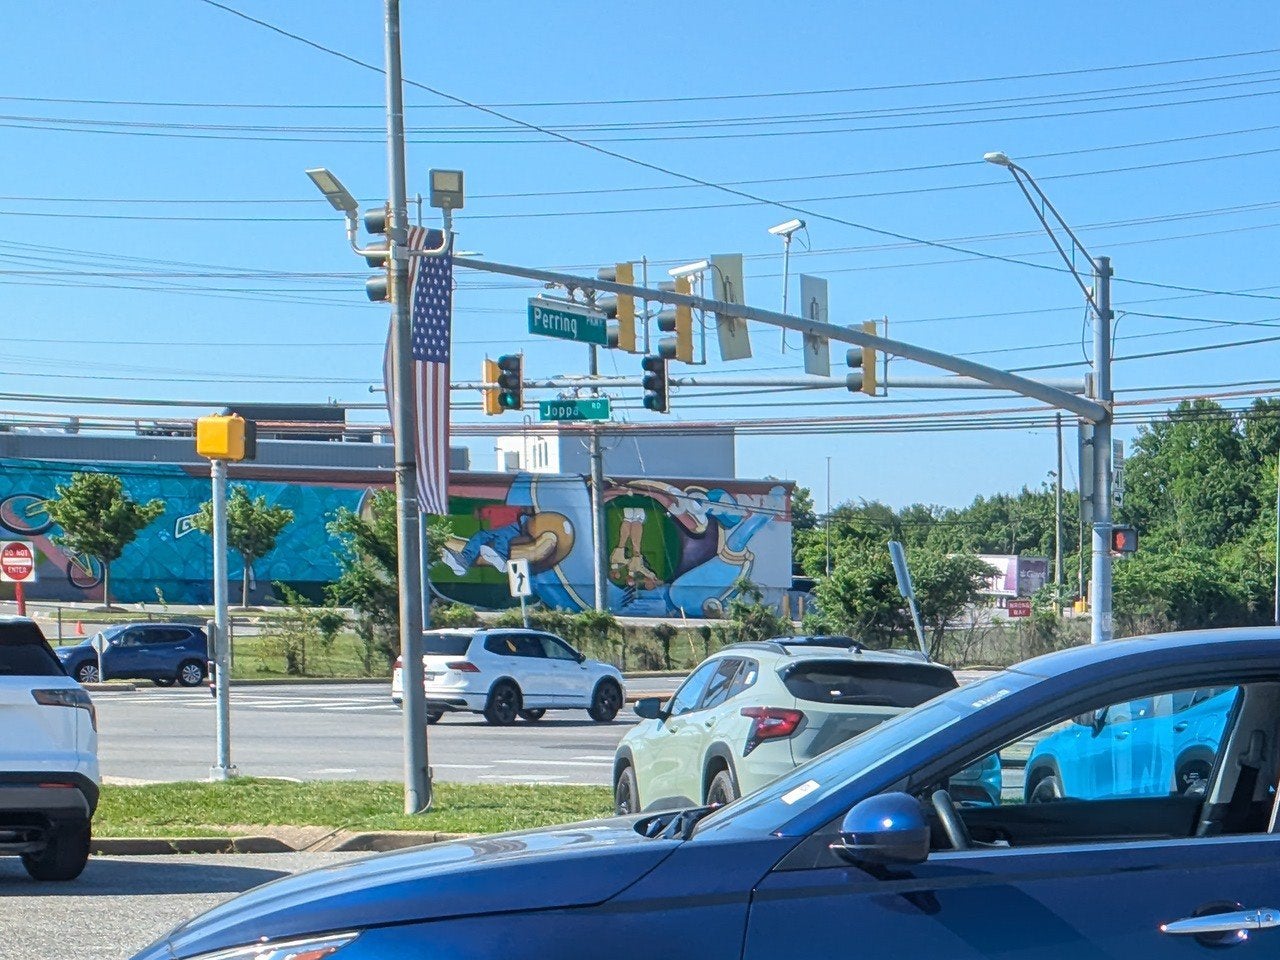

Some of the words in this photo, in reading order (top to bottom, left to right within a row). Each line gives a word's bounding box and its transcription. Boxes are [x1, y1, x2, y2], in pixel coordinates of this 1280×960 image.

[533, 308, 578, 339] Perring
[544, 405, 579, 418] Joppa
[591, 401, 601, 409] RD
[4, 549, 14, 557] DO
[16, 549, 28, 557] NOT
[7, 566, 27, 574] ENTER
